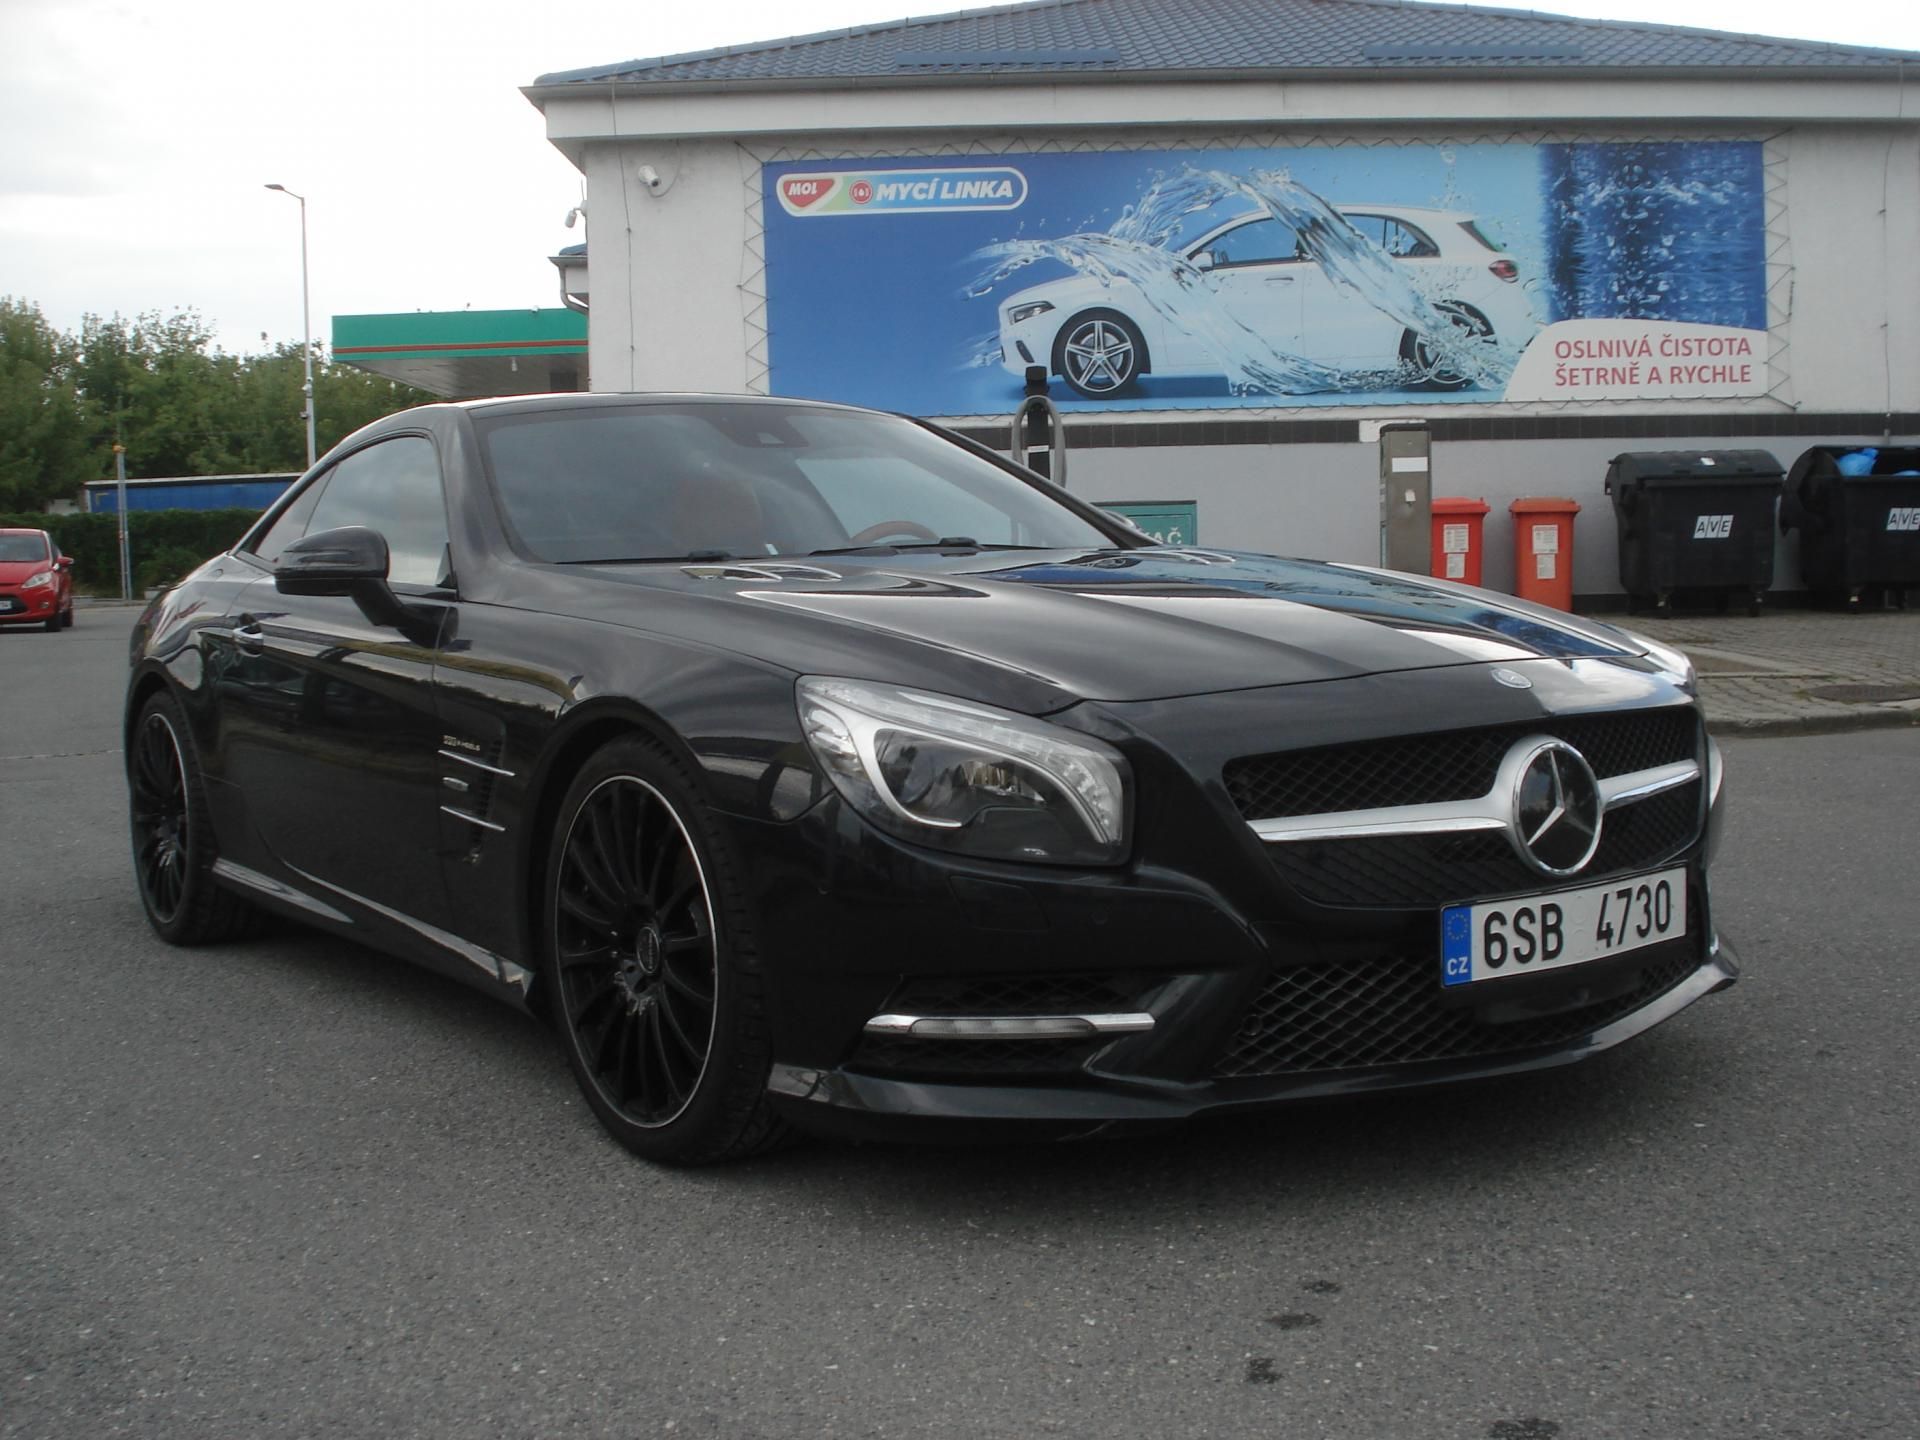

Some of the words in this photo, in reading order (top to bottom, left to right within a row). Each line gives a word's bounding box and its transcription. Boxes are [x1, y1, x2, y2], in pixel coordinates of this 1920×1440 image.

[788, 183, 818, 196] MOL
[876, 177, 940, 201] MYCÍ
[941, 180, 1013, 200] LINKA
[1555, 334, 1653, 359] OSLNIVÁ
[1659, 334, 1752, 357] ČISTOTA
[1555, 362, 1640, 386] ŠETRNĚ
[1647, 366, 1663, 385] A
[1670, 365, 1752, 384] RYCHLE
[1695, 520, 1730, 533] AVE
[1888, 512, 1920, 526] AVE
[1483, 903, 1564, 969] 6SB
[1596, 879, 1672, 949] 4730
[1447, 956, 1469, 976] CZ
